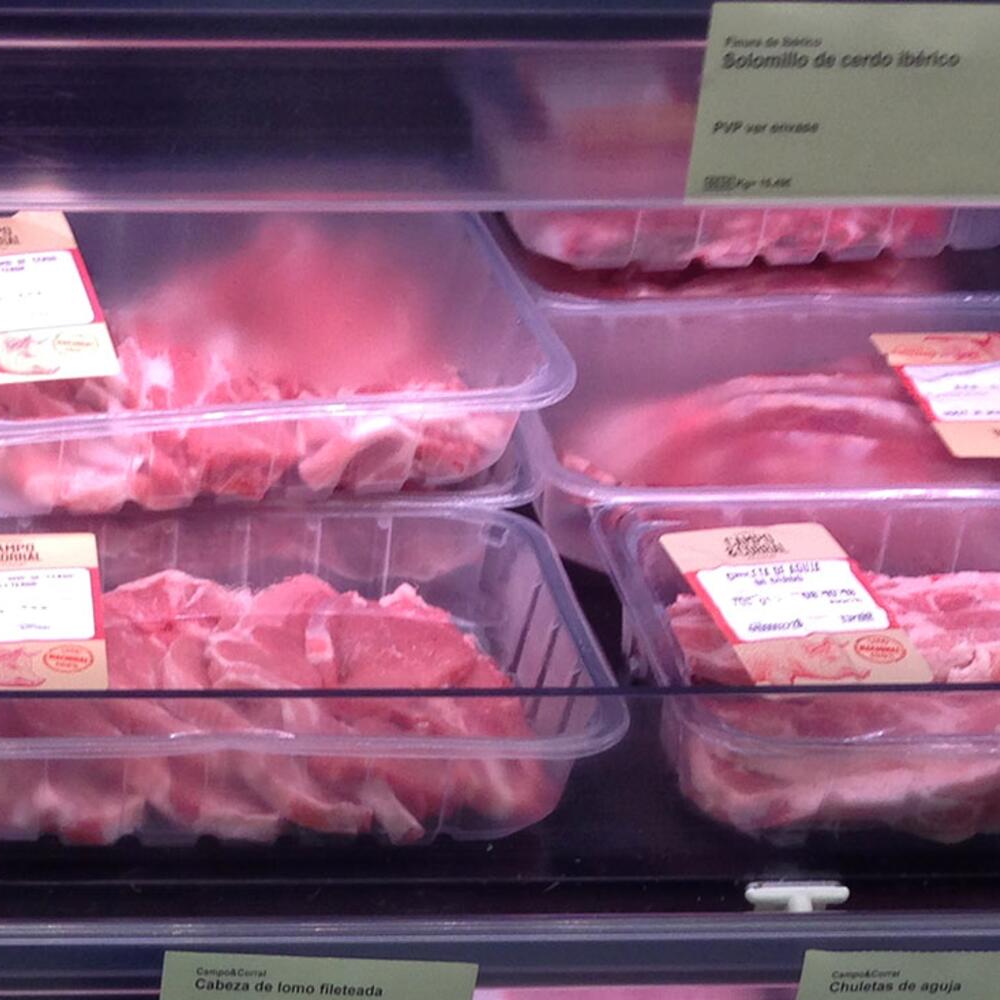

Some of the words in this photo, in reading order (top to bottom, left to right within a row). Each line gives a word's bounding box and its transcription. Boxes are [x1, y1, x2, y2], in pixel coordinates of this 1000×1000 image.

[765, 37, 780, 48] de
[722, 52, 809, 69] Solomillo
[813, 52, 835, 68] de
[840, 51, 893, 68] cerdo
[897, 49, 961, 67] ibérico
[712, 121, 742, 134] PVP
[769, 122, 819, 134] envase
[196, 967, 267, 979] Campo&Corral
[195, 978, 250, 992] Cabeza
[254, 980, 273, 993] de
[277, 981, 315, 995] lomo
[319, 983, 383, 998] fileteada
[829, 980, 893, 993] Chuletas
[898, 980, 916, 992] de
[920, 981, 962, 995] aguja
